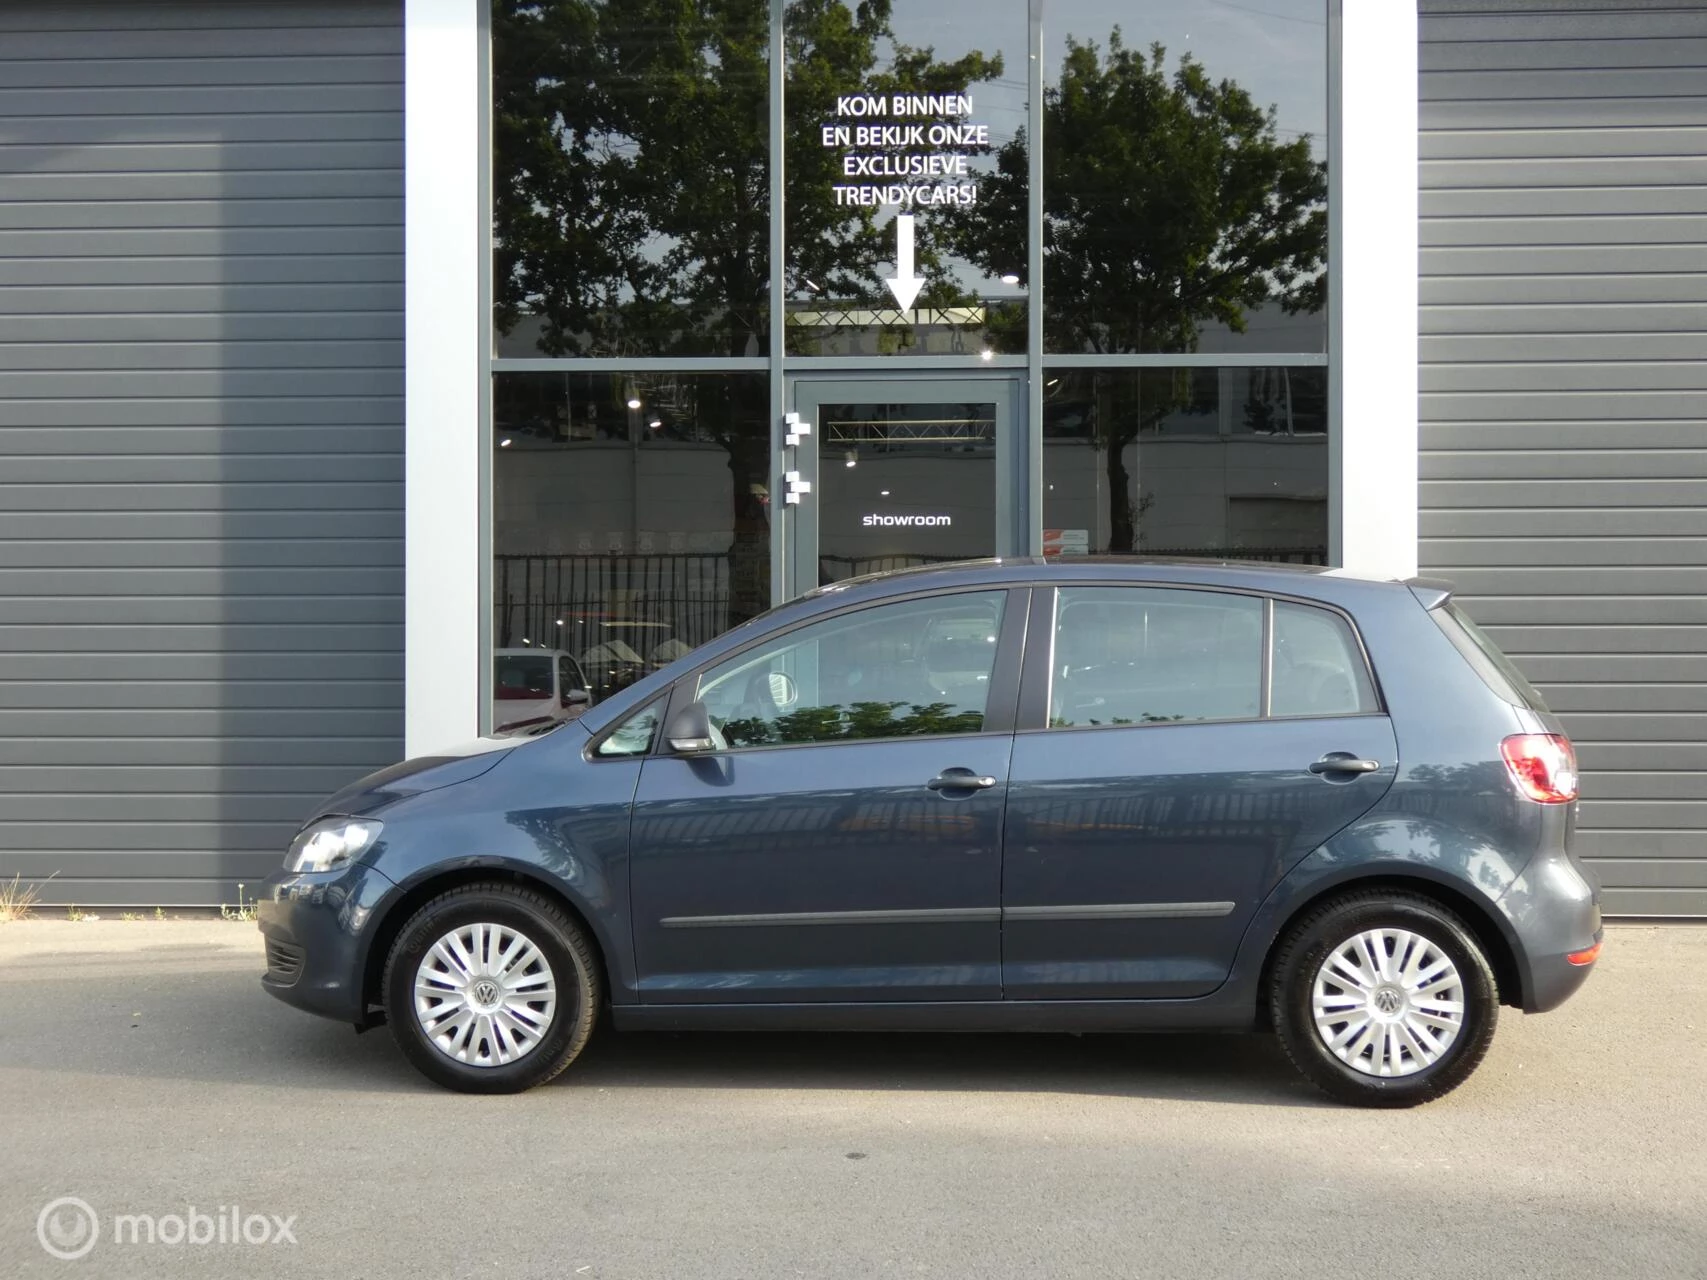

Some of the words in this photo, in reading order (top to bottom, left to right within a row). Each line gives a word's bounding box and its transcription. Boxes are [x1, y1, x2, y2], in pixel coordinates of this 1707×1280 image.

[836, 96, 887, 116] KOM
[892, 95, 973, 115] BINNEN
[822, 127, 850, 146] EN
[855, 126, 925, 146] BEKIJK
[928, 125, 989, 145] ONZE
[843, 155, 968, 176] EXCLUSIEVE
[832, 185, 977, 205] TRENDYCARS!
[862, 513, 952, 526] showroom
